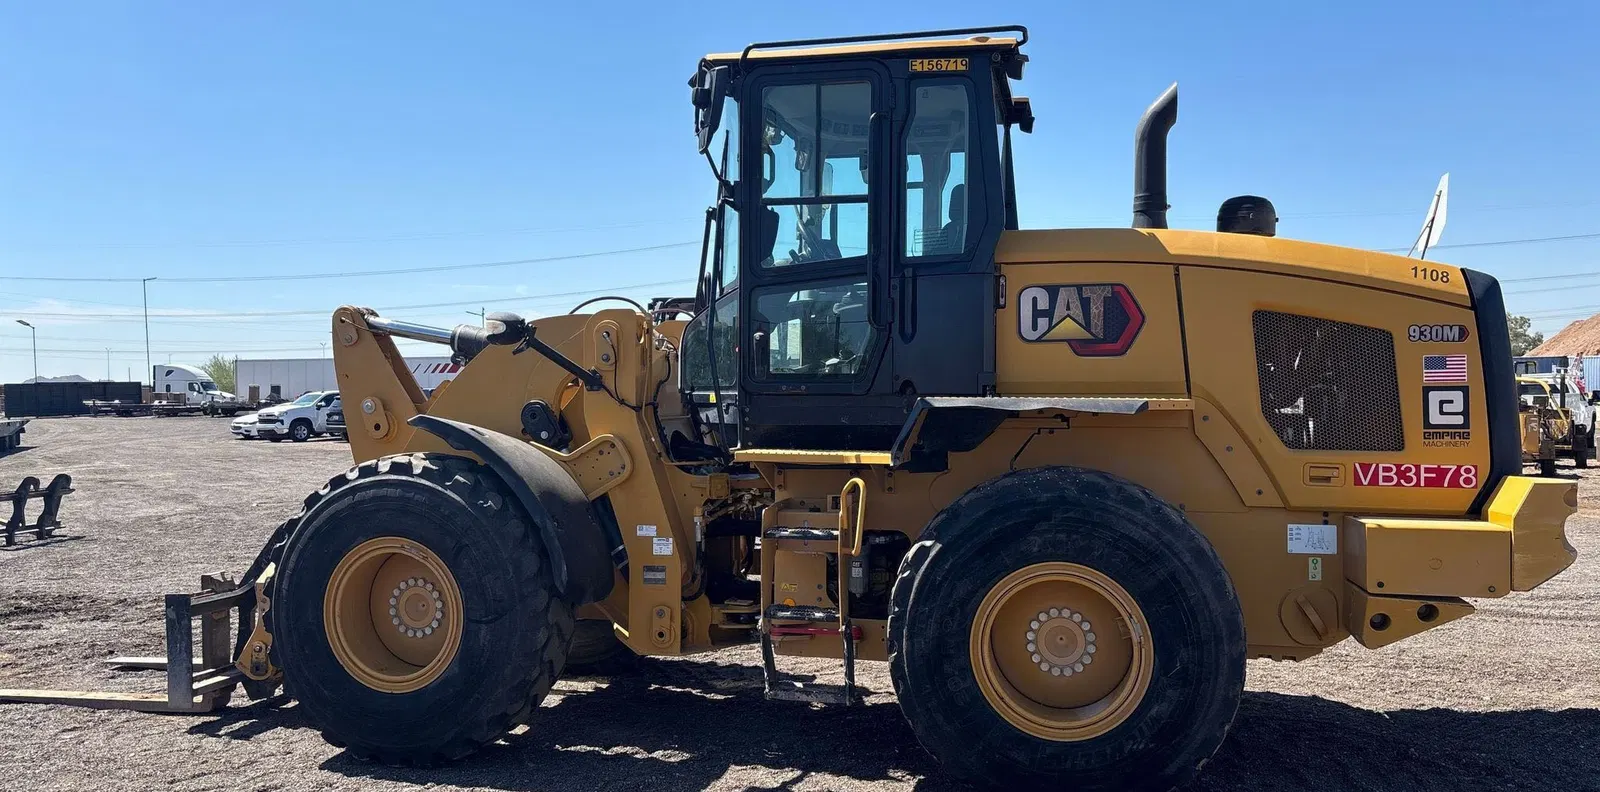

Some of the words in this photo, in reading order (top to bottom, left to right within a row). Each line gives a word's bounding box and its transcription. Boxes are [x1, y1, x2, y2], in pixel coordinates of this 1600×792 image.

[911, 59, 968, 71] E156719
[1411, 266, 1450, 283] 1108
[1020, 285, 1112, 341] CAT
[1409, 325, 1460, 342] 930M
[1354, 462, 1477, 488] VB3F78
